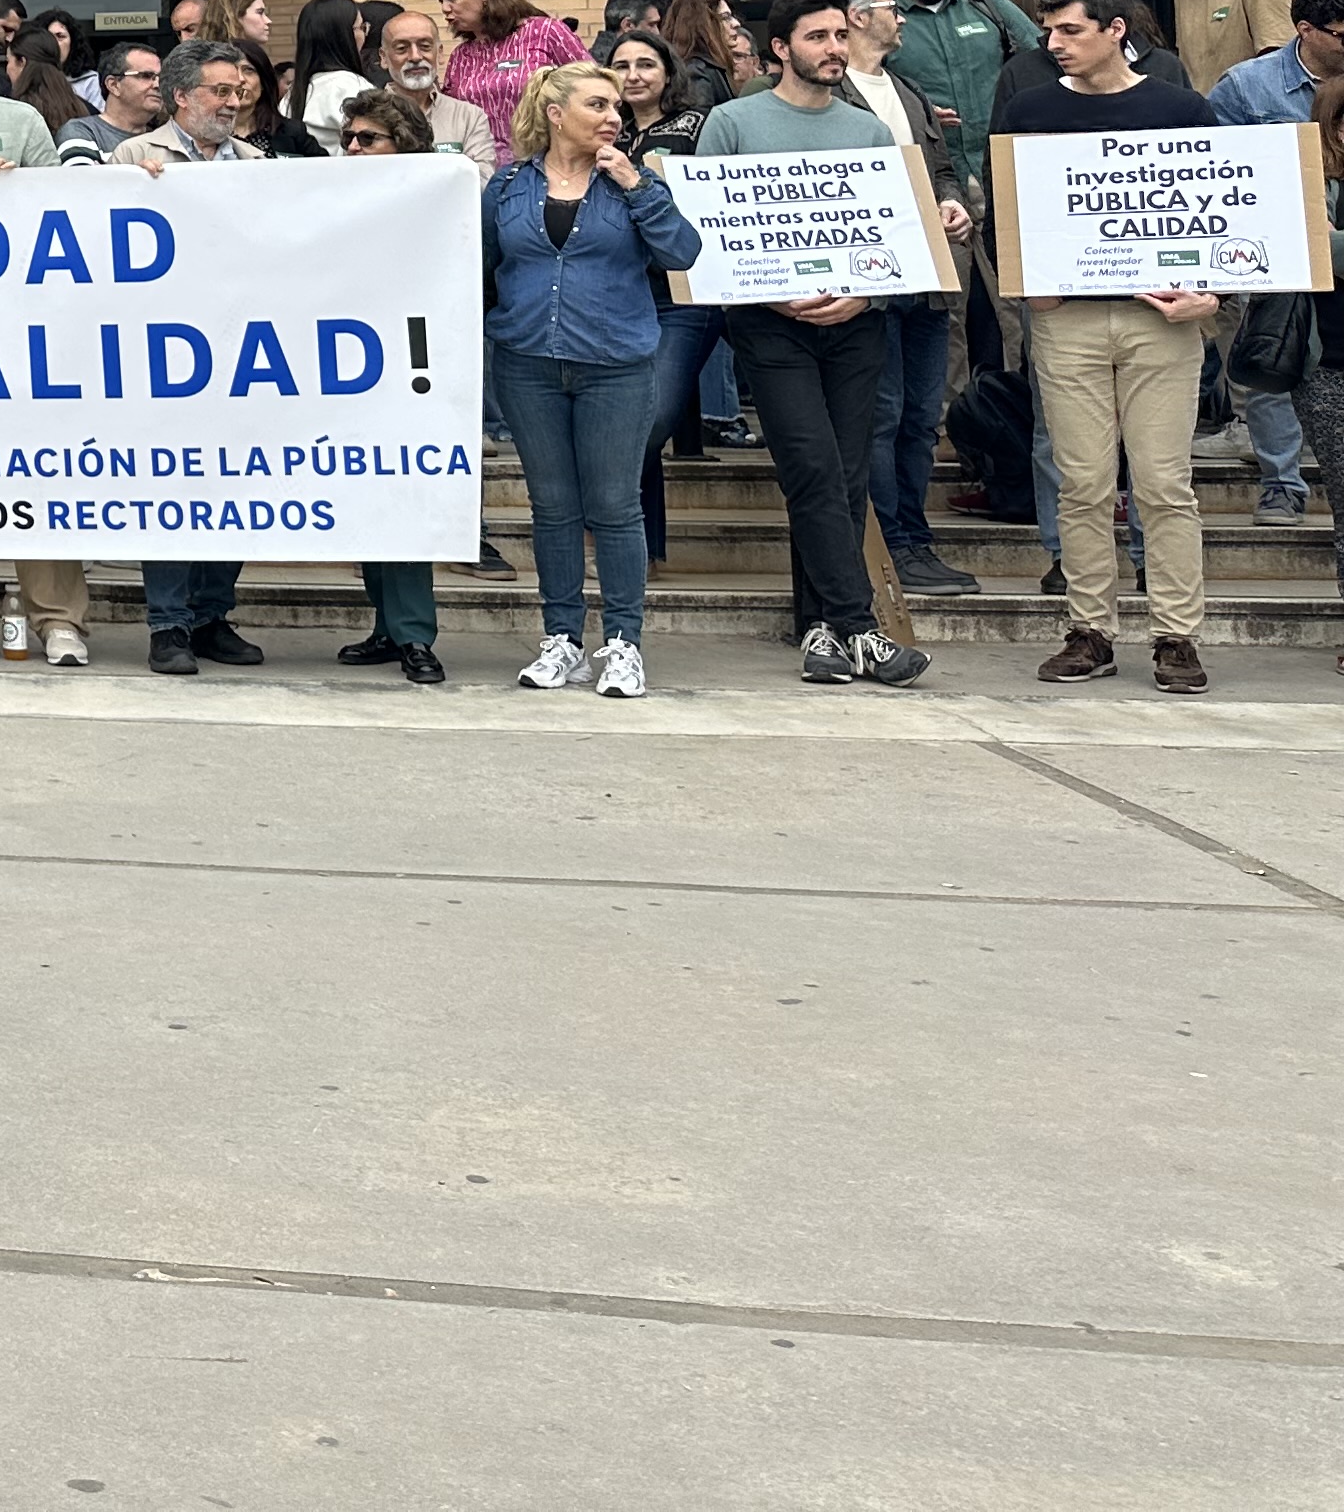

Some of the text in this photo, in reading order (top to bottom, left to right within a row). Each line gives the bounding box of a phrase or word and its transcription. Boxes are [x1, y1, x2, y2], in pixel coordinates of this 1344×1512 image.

[103, 15, 149, 26] ENTRADA
[1101, 138, 1211, 157] Por una
[683, 158, 886, 181] La Junta ahoga a
[1066, 159, 1254, 188] investigación
[723, 179, 856, 204] la PÚBLICA
[1067, 186, 1257, 214] PÚBLICA y de
[699, 207, 894, 228] mientras aupa a
[1099, 215, 1229, 239] CALIDAD
[720, 226, 884, 252] las PRIVADAS
[1084, 246, 1134, 255] Colectivo
[1076, 257, 1144, 267] Investigador
[1082, 269, 1096, 277] de
[739, 278, 750, 287] de
[152, 448, 205, 477] DE
[218, 446, 272, 477] LA
[283, 435, 472, 477] PÚBLICA
[47, 500, 336, 532] RECTORADOS
